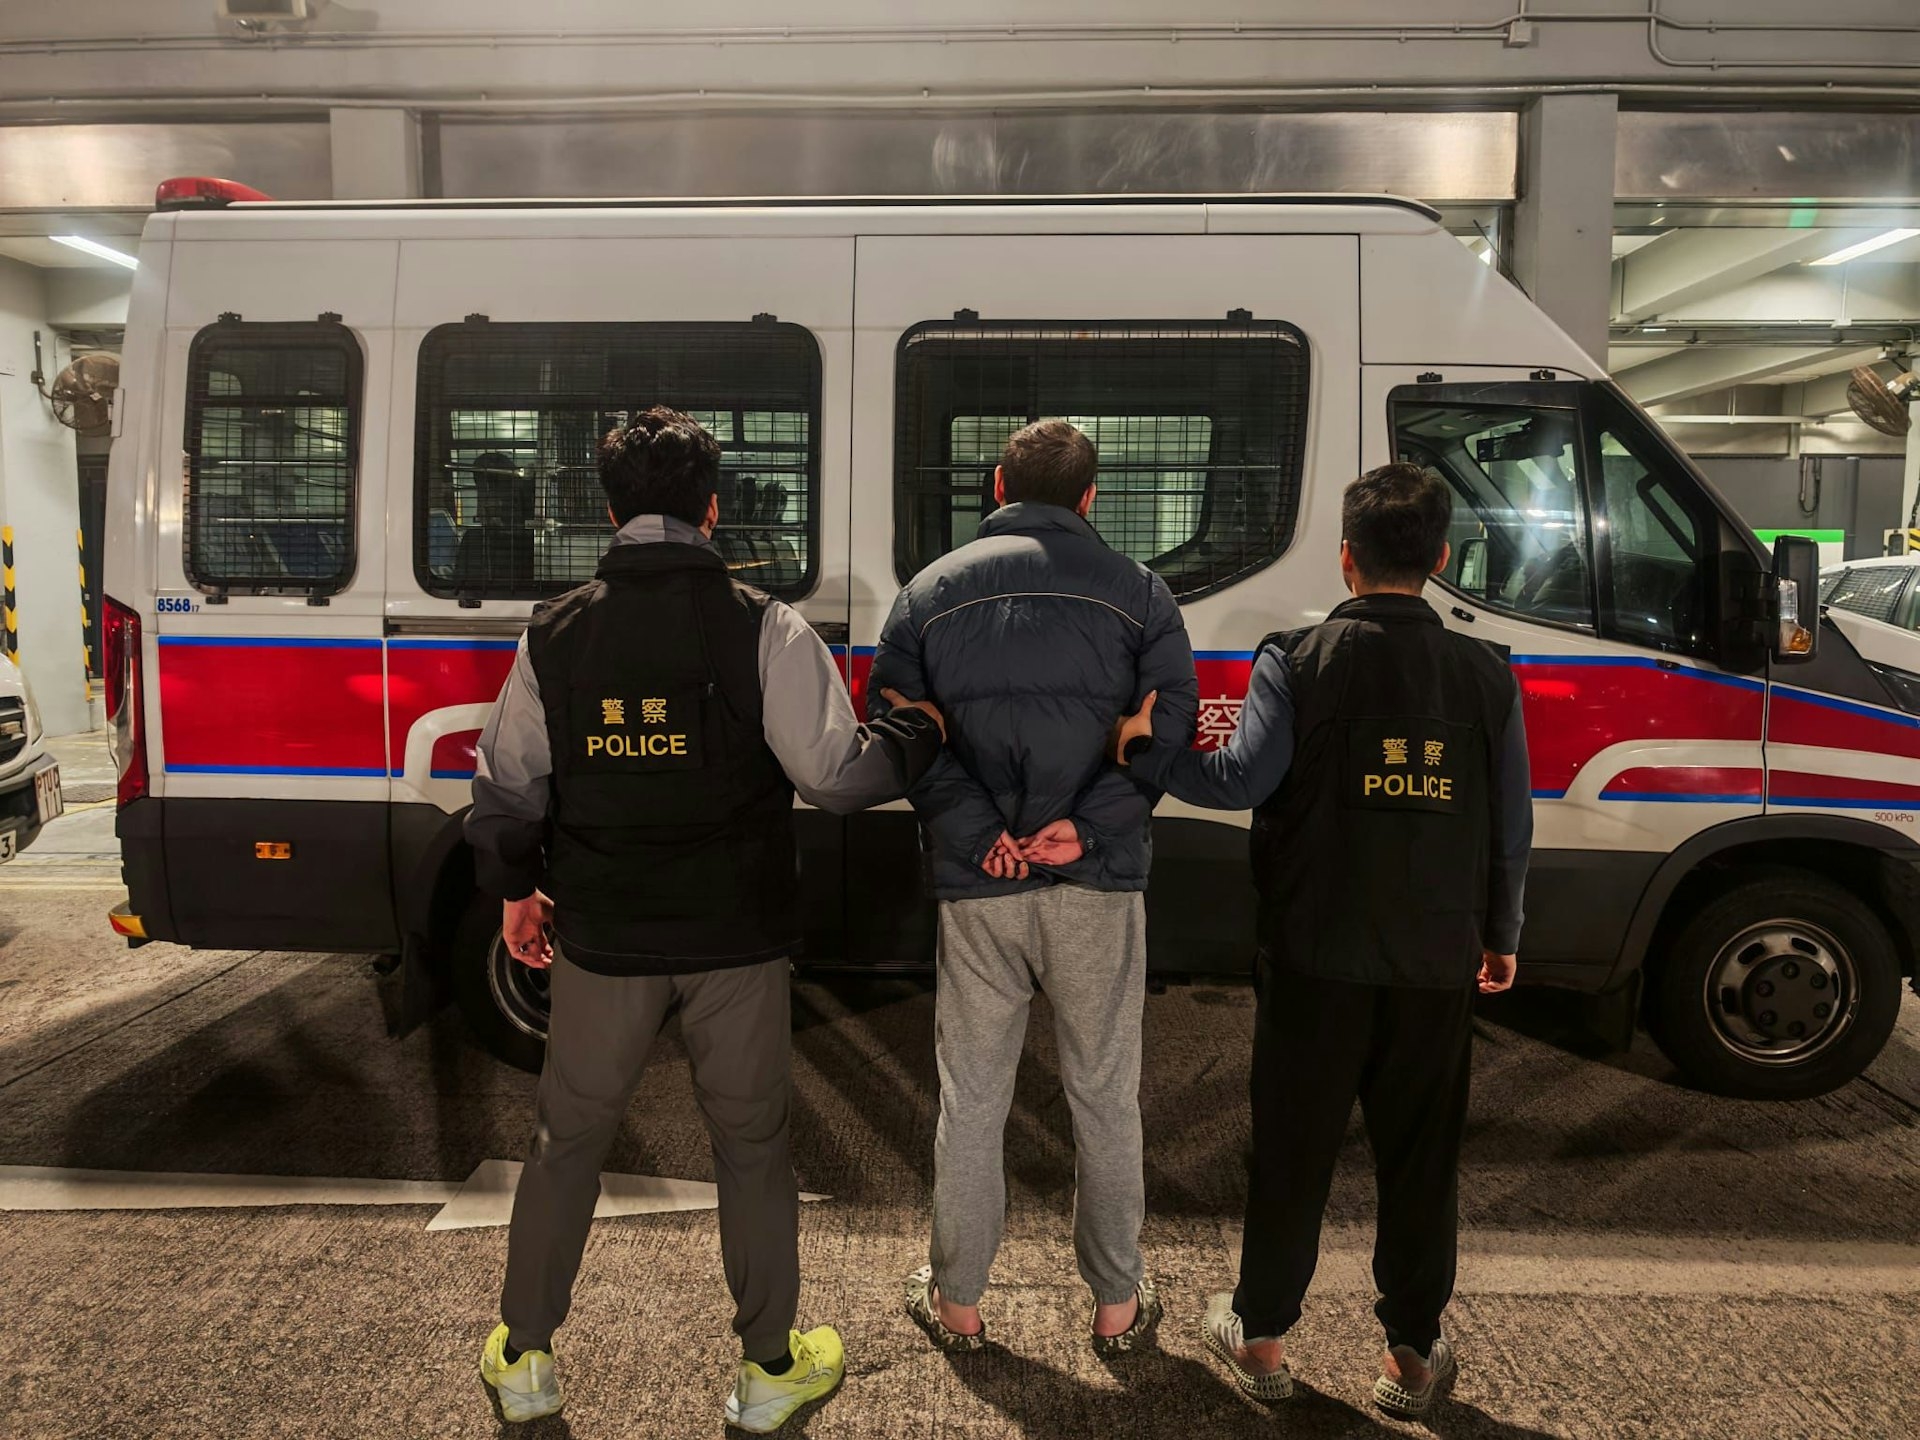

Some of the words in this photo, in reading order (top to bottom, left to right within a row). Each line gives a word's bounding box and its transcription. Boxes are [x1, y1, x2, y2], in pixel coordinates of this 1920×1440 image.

[157, 598, 191, 612] 8568
[601, 697, 667, 725] 警察
[1198, 694, 1245, 748] 察
[586, 734, 688, 757] POLICE
[1382, 738, 1444, 766] 警察
[1364, 774, 1453, 800] POLICE
[1874, 811, 1893, 822] 500
[1895, 813, 1914, 823] kPa
